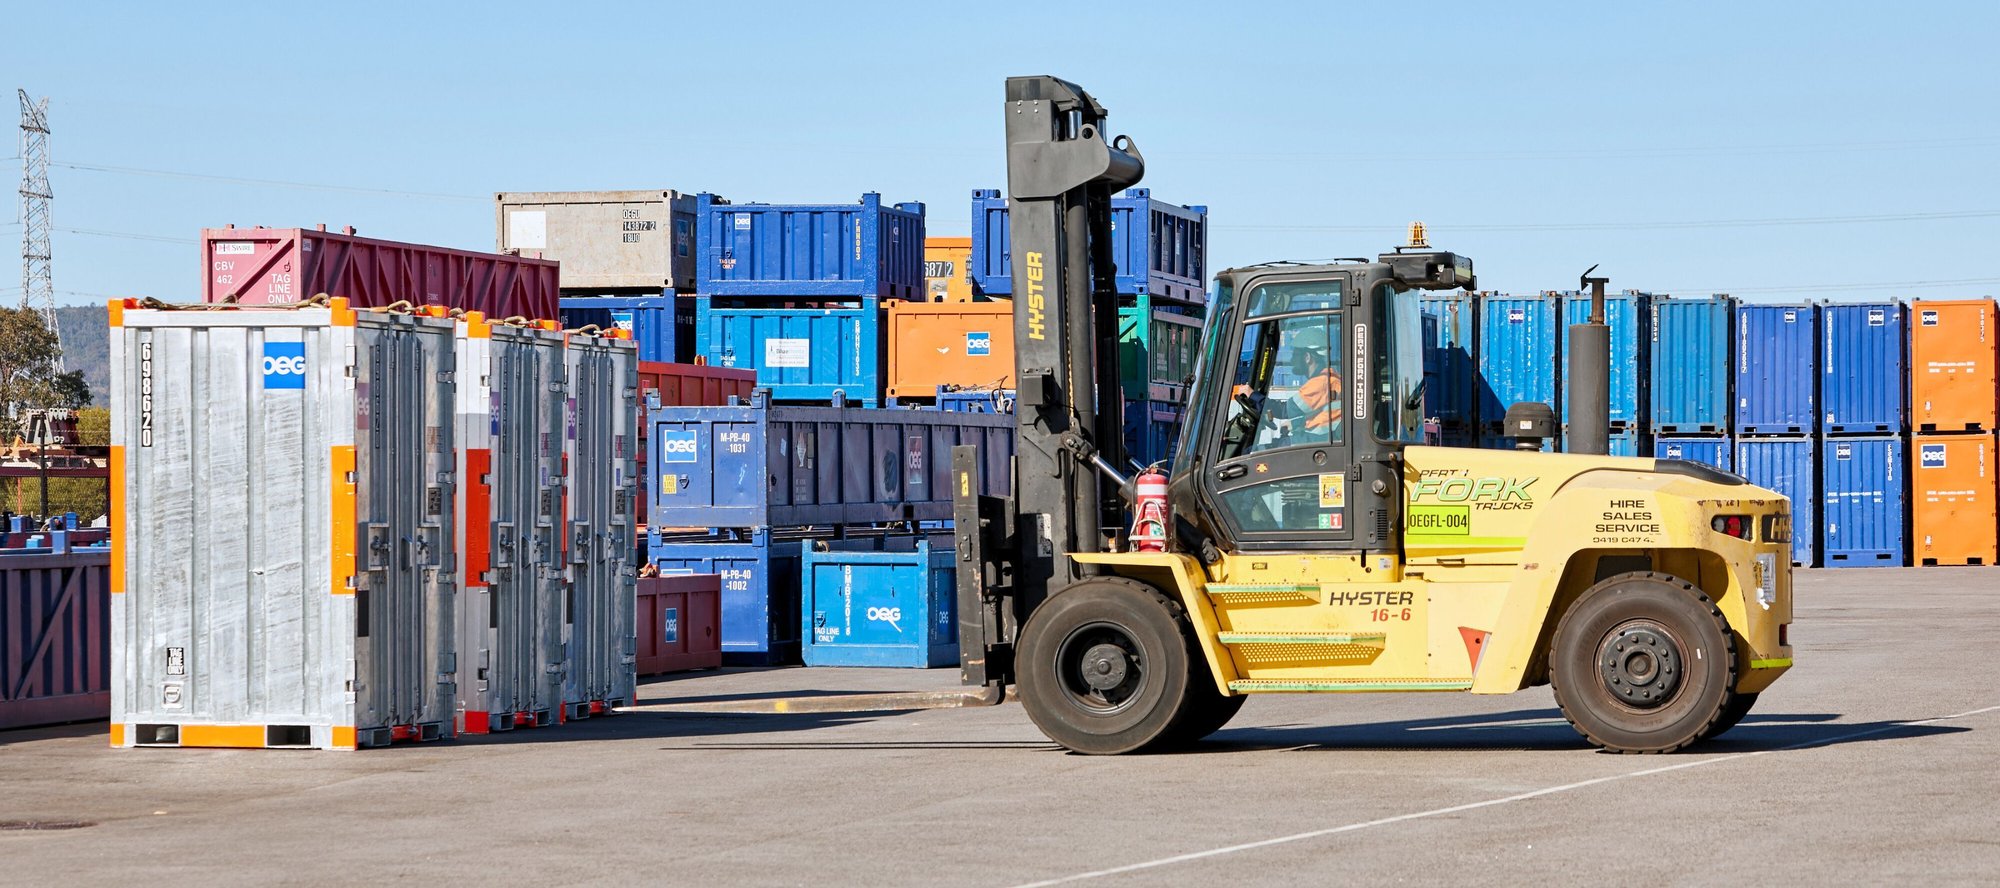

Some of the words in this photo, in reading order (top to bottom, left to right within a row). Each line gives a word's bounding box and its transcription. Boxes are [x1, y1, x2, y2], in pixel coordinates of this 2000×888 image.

[215, 261, 235, 271] CBV
[217, 275, 233, 284] 462
[271, 273, 291, 283] TAG
[269, 284, 291, 294] LINE
[267, 294, 293, 304] ONLY
[1027, 252, 1045, 341] HYSTER
[142, 343, 152, 447] 698620
[720, 432, 750, 443] M-PB-40
[1411, 477, 1540, 502] FORK
[1475, 502, 1534, 510] TRUCKS
[1610, 500, 1645, 508] HIRE
[1409, 514, 1467, 527] OEGFL-004
[1603, 512, 1652, 520] SALES
[1595, 524, 1660, 532] SERVICE
[721, 569, 751, 580] M-PB-40
[1329, 591, 1414, 606] HYSTER
[1370, 607, 1411, 622] 16-6
[814, 627, 825, 635] TAG
[826, 627, 839, 635] LINE
[818, 635, 835, 643] ONLY
